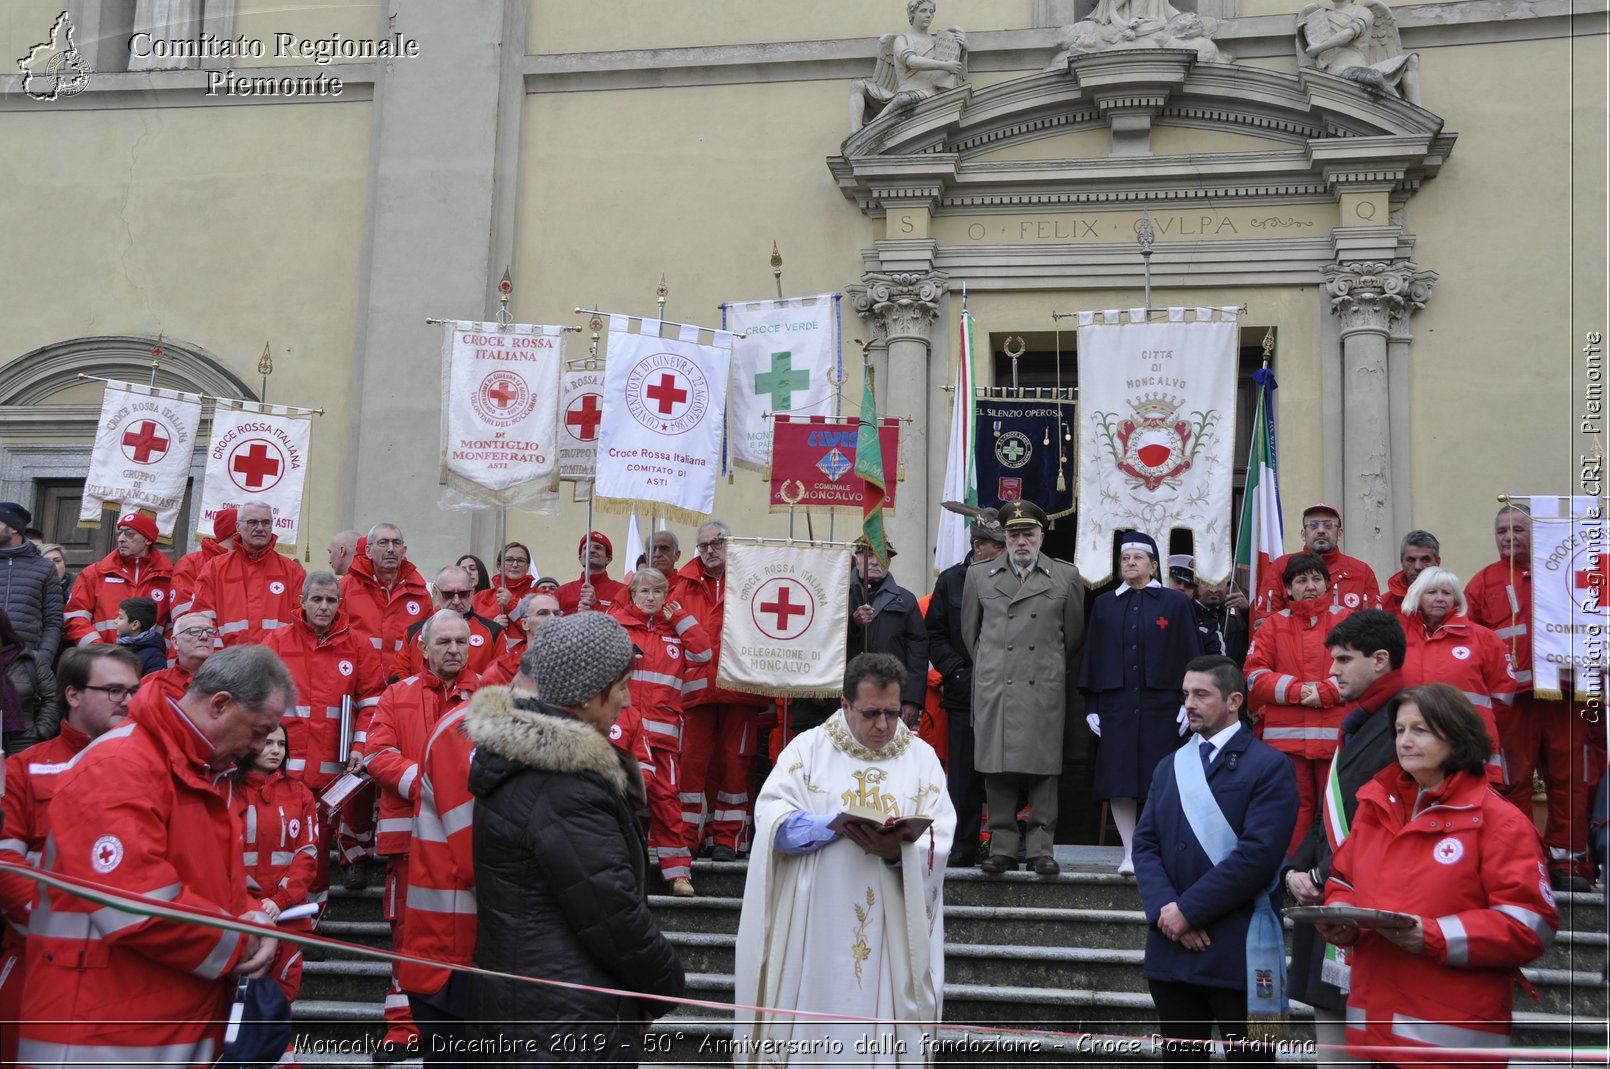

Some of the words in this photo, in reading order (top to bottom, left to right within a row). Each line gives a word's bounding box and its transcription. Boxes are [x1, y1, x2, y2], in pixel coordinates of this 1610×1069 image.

[1020, 220, 1099, 239] FELIX
[746, 324, 781, 336] CROCE
[785, 321, 819, 331] VERDE
[462, 334, 505, 348] CROCE
[512, 336, 553, 349] ROSSA
[476, 350, 537, 362] ITALIANA
[640, 361, 653, 373] DI
[652, 355, 694, 376] GINEVRA
[1151, 363, 1162, 373] DI
[570, 375, 598, 390] ROSSA
[692, 376, 704, 388] 22
[1126, 377, 1187, 389] MONCALVO
[628, 371, 660, 429] CONVENZIONE
[687, 389, 706, 425] AGOSTO
[470, 391, 495, 426] VOLONTARI
[495, 420, 511, 428] DEL
[511, 392, 538, 425] SOCCORSO
[975, 408, 985, 416] EL
[987, 408, 1023, 418] SILENZIO
[1025, 408, 1064, 418] OPEROSA
[107, 406, 130, 431] CROCE
[132, 402, 160, 413] ROSSA
[161, 406, 188, 444] ITALIANA
[212, 430, 237, 460] CROCE
[237, 422, 272, 434] ROSSA
[273, 428, 301, 470] ITALIANA
[460, 440, 539, 451] MONTIGLIO
[452, 451, 546, 464] MONFERRATO
[608, 448, 638, 458] Croce
[641, 449, 671, 461] Rossa
[673, 453, 706, 466] Italiana
[488, 462, 508, 470] ASTI
[626, 464, 673, 475] COMITATO
[122, 469, 156, 483] GRUPPO
[646, 478, 668, 486] ASTI
[133, 481, 142, 489] DI
[814, 482, 851, 491] COMUNALE
[87, 483, 150, 502] VILLAFRANCA
[151, 494, 180, 509] D'ASTI
[803, 490, 864, 501] MONCALVO
[222, 502, 243, 510] COMIT
[272, 507, 280, 515] DI
[274, 517, 294, 529] 'ASTI
[1545, 536, 1581, 572] CROCE
[740, 573, 761, 602] CROCE
[764, 563, 795, 575] ROSSA
[800, 569, 828, 608] ITALIANA
[741, 645, 804, 660] DELEGAZIONE
[811, 651, 821, 660] DI
[750, 659, 811, 674] MONCALVO
